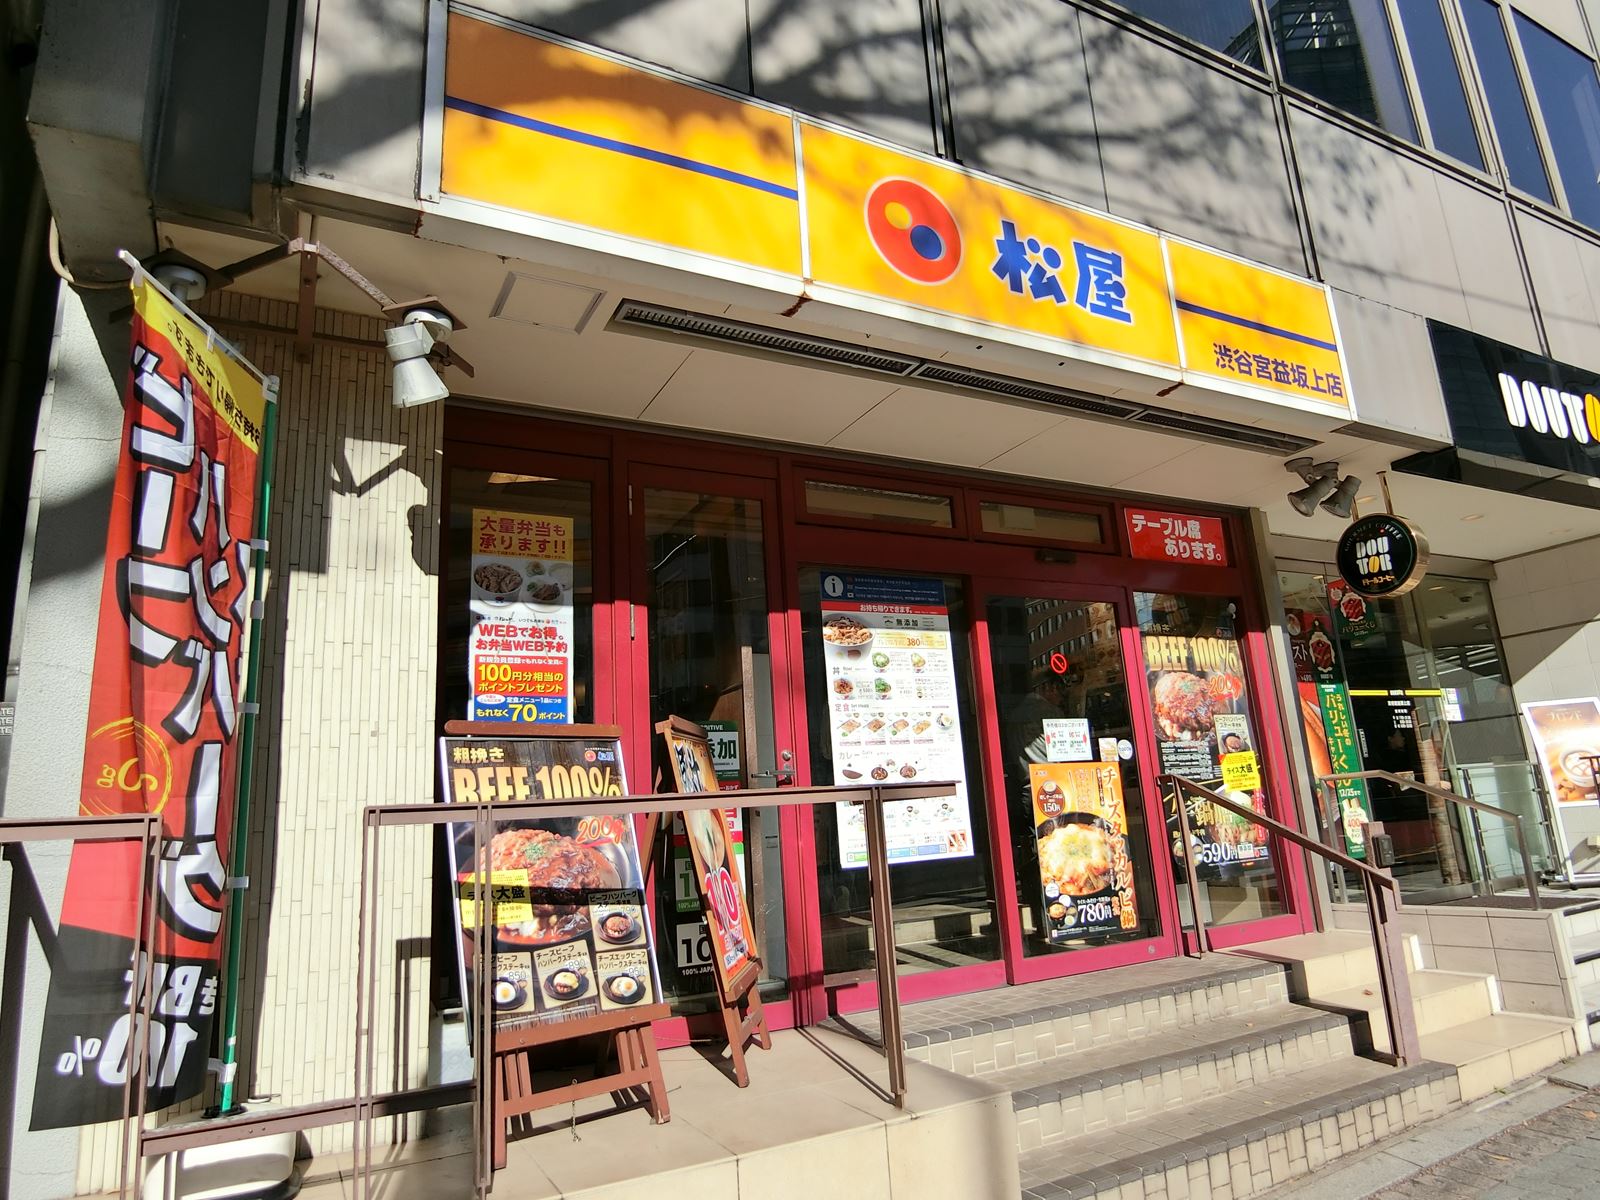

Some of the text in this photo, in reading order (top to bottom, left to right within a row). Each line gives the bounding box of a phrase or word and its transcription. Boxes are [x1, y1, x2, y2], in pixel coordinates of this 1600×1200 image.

[992, 219, 1132, 324] 松屋
[1212, 342, 1344, 399] 渋谷宮益坂上店
[479, 515, 566, 537] 大量弁当も
[1131, 514, 1202, 539] テーブル席
[479, 532, 566, 554] 承ります!!
[1164, 534, 1222, 561] あります。
[1355, 536, 1389, 559] DOU
[1355, 553, 1393, 576] TOR
[860, 604, 913, 614] お持ち帰りできます。
[478, 623, 564, 640] WEBでお得。
[475, 638, 568, 653] お弁当WEB予約
[1146, 635, 1239, 673] BEEF 100%
[478, 663, 564, 682] 100円分相当の
[478, 681, 564, 694] ポイントプレゼント
[453, 746, 505, 763] 粗挽き
[590, 889, 637, 902] ビーフハンバーグ
[1078, 903, 1113, 923] 780円
[536, 944, 575, 960] チーズビーフ
[598, 951, 647, 962] チーズエッグビーフ
